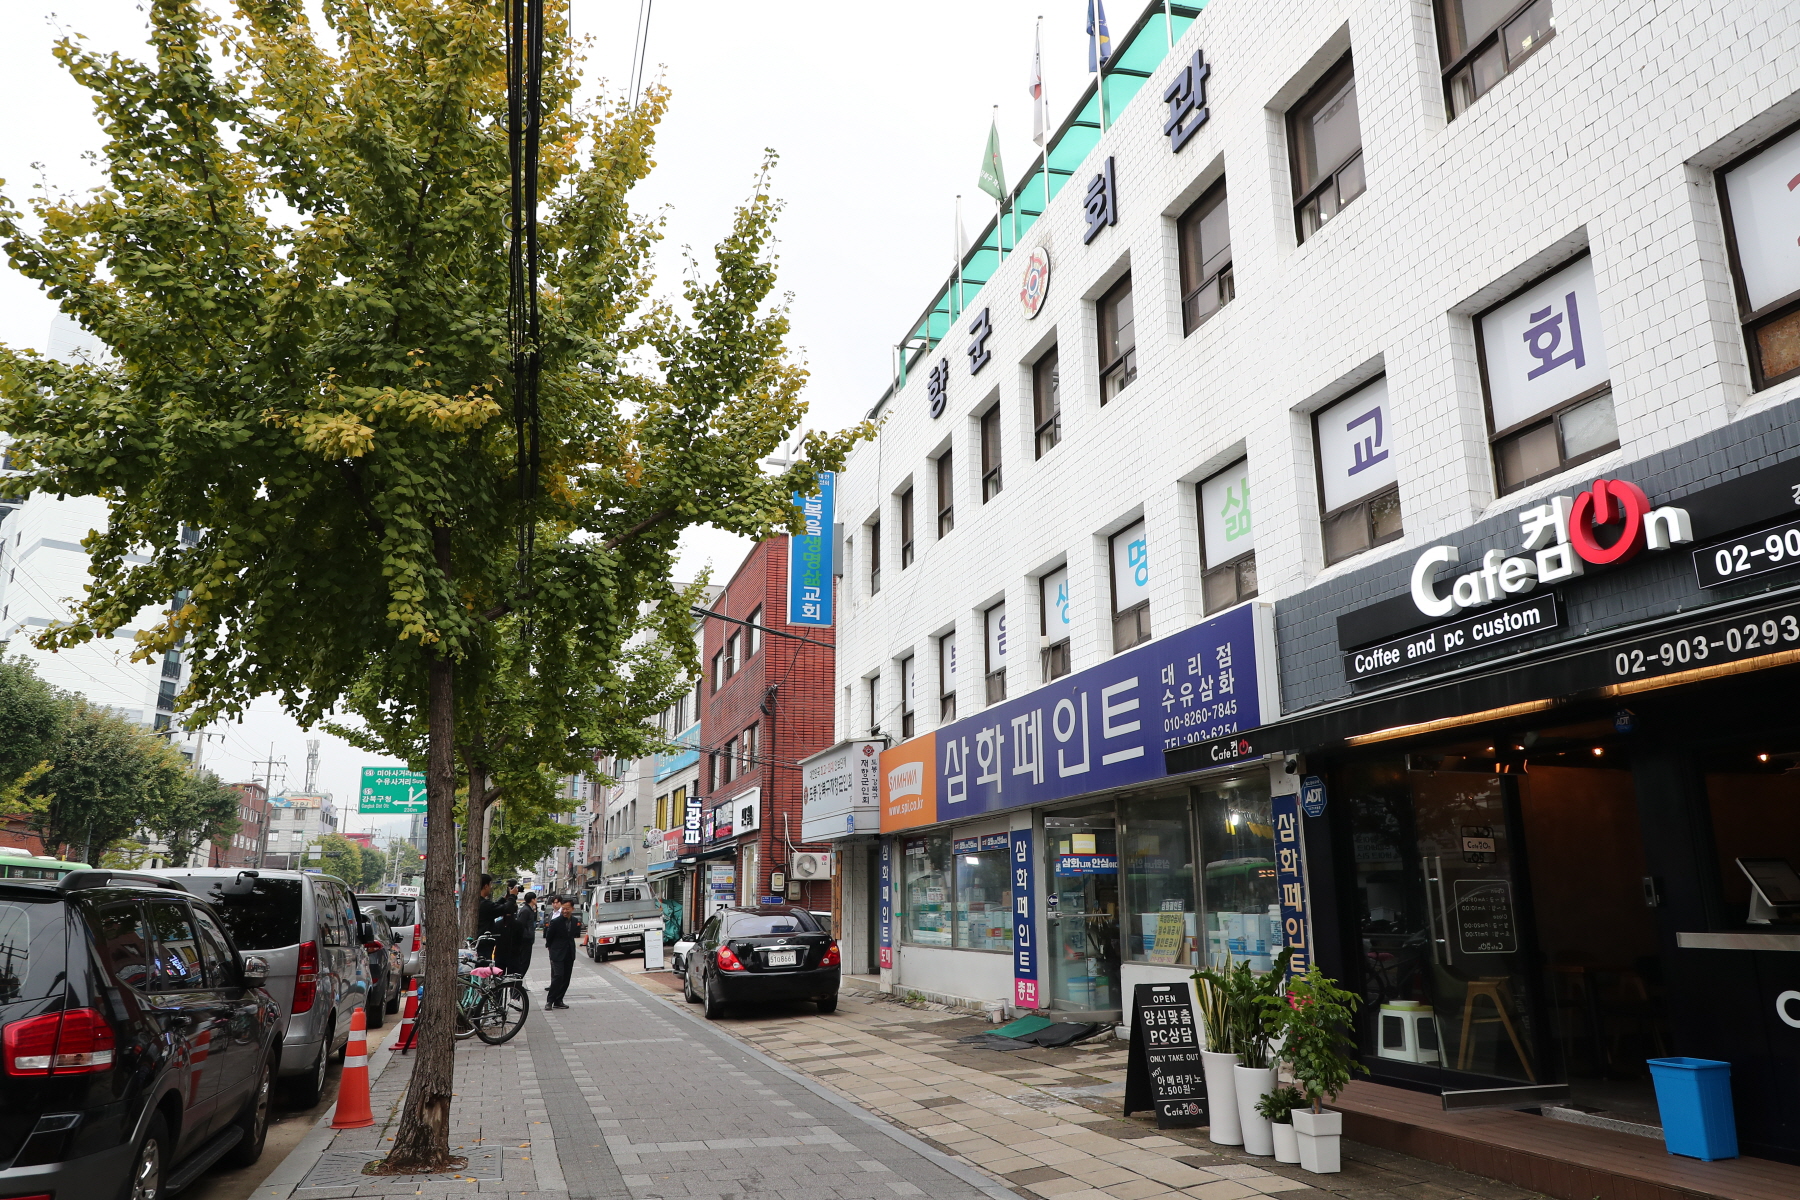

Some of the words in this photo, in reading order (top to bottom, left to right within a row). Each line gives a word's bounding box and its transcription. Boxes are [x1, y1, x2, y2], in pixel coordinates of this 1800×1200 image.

[1355, 648, 1400, 674] Coffee
[1407, 633, 1436, 659] and
[1443, 629, 1464, 651] pc
[1472, 607, 1541, 641] custom
[1615, 615, 1800, 676] 02-903-0293
[1161, 642, 1232, 686] 대리점
[1164, 700, 1237, 732] 010-8260-7845
[943, 676, 1145, 804] 삼화페인트
[861, 759, 869, 804] 재향군인회
[362, 795, 392, 803] 강북구청
[1305, 787, 1322, 804] ADT
[1062, 857, 1091, 868] 삼화니까
[1014, 840, 1031, 973] 삼화페인트
[614, 923, 646, 931] HYUNDAI
[1017, 980, 1036, 1002] 총판
[1152, 994, 1177, 1004] OPEN
[1150, 1027, 1192, 1044] PC상담
[1149, 1054, 1167, 1063] ONLY
[1168, 1053, 1185, 1062] TAKE
[1186, 1053, 1199, 1061] OUT
[1151, 1066, 1163, 1078] HOT
[1157, 1073, 1202, 1086] 아메리카노
